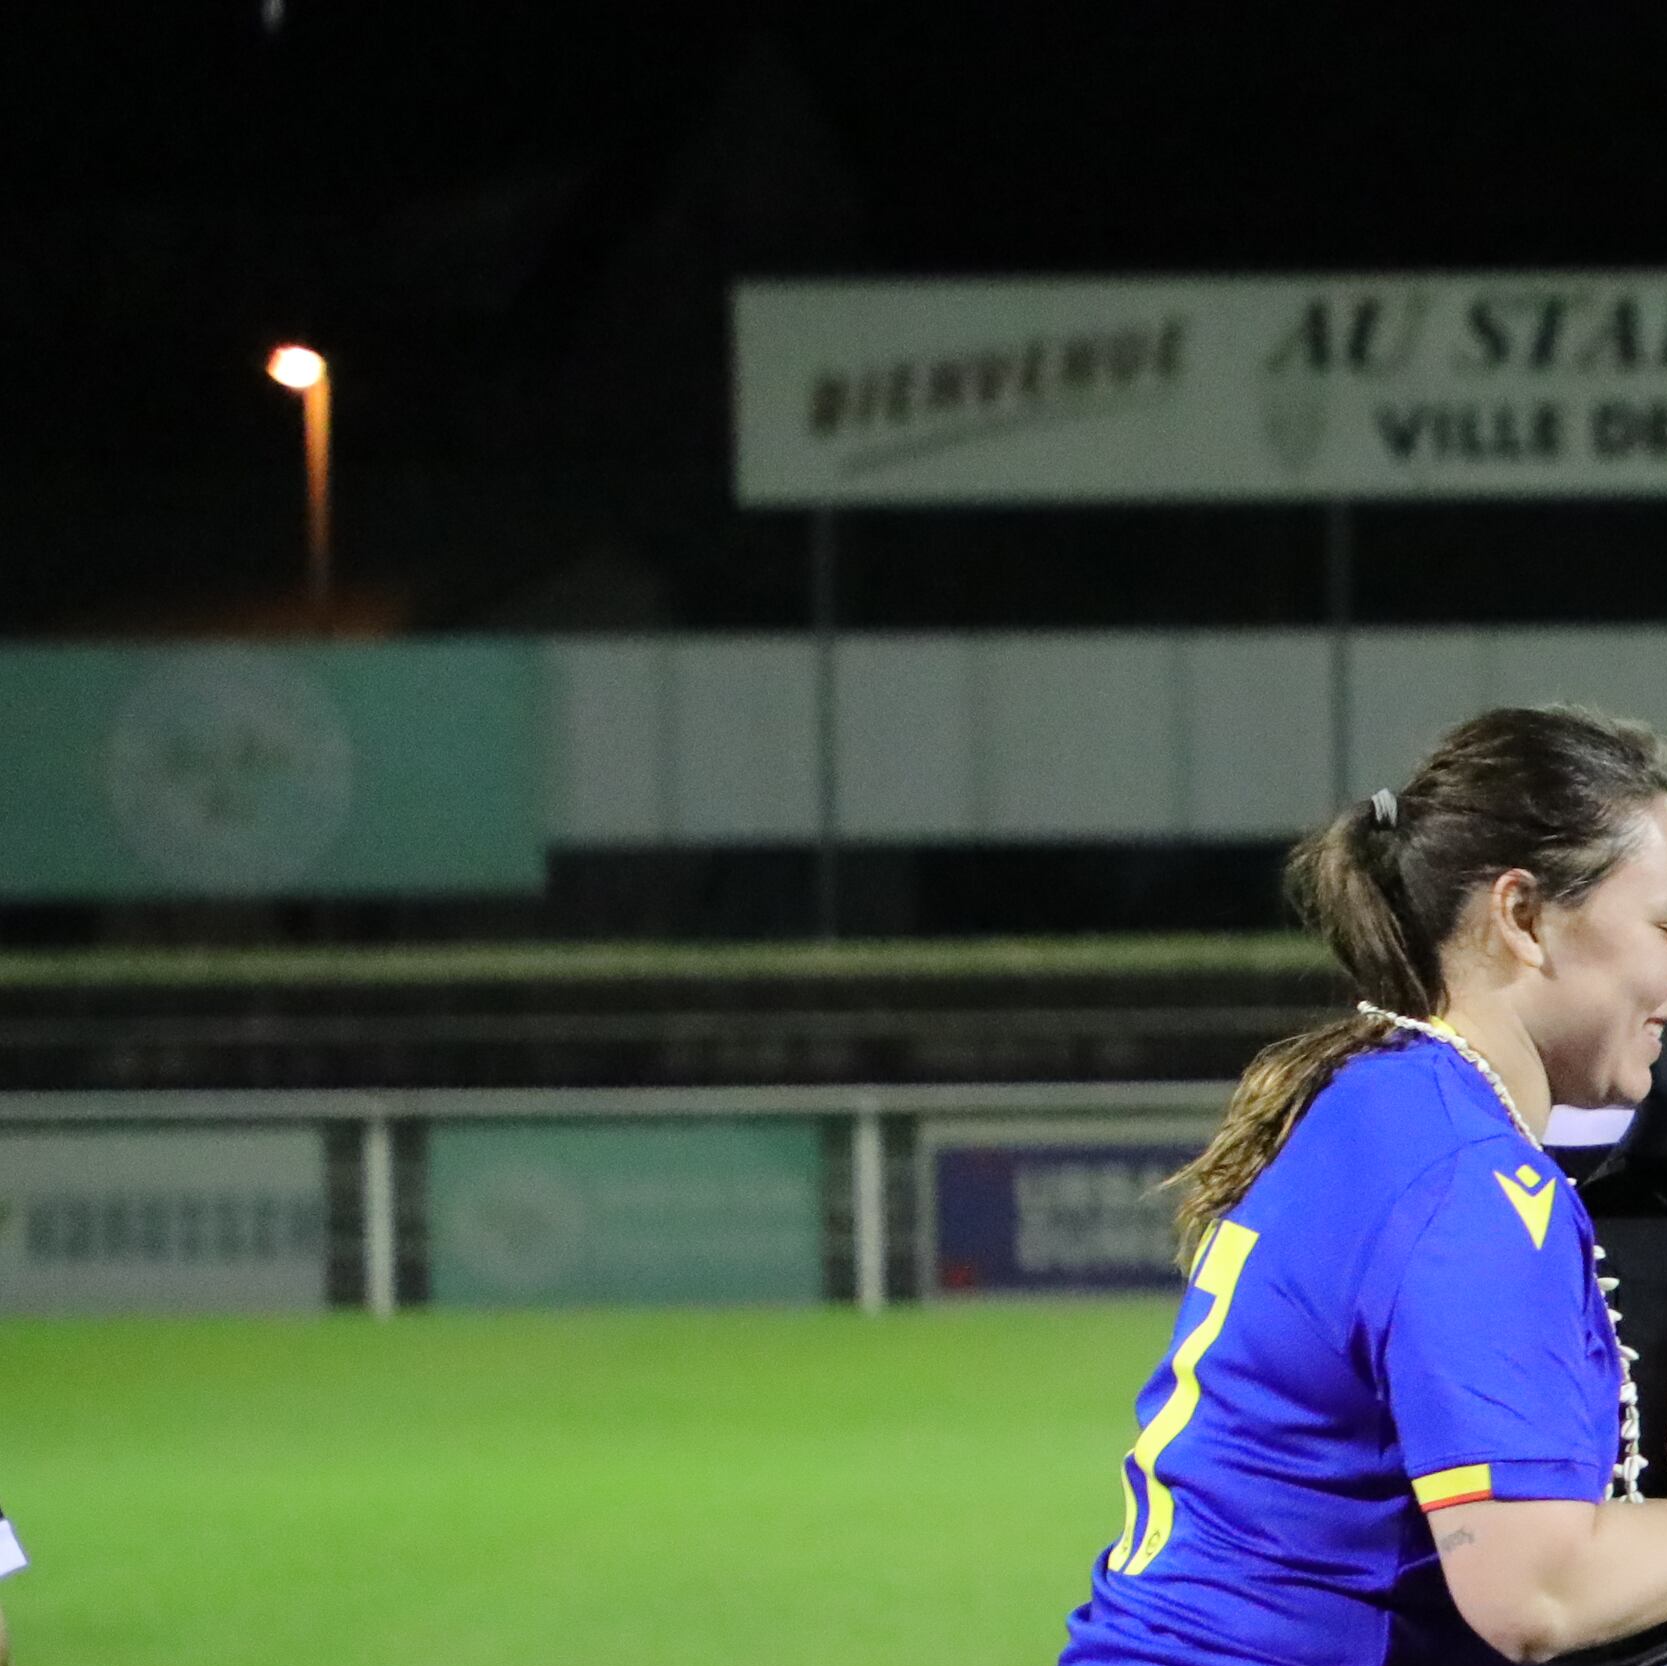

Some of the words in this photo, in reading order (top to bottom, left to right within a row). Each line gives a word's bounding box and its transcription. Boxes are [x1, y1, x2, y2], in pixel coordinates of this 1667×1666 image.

[808, 306, 1187, 439] BIENVENUE
[1264, 294, 1436, 376] AU
[1371, 398, 1562, 461] VILLE
